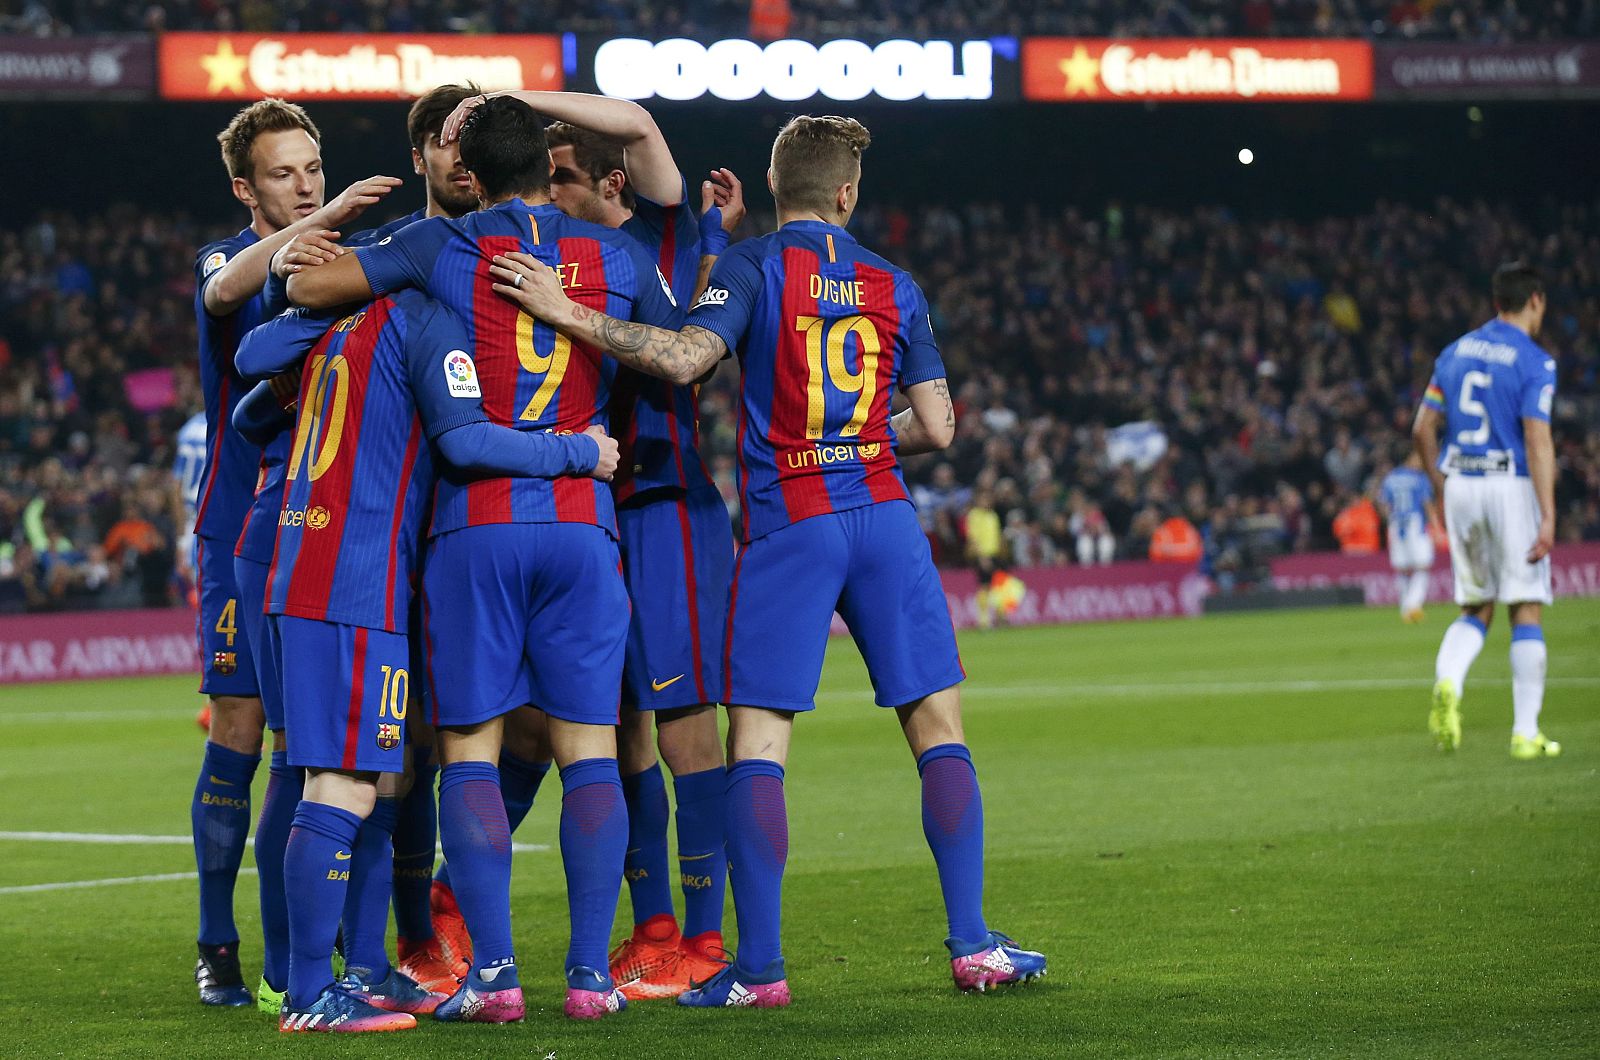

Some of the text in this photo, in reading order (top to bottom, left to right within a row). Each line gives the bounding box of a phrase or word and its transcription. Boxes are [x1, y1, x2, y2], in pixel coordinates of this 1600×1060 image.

[697, 286, 729, 303] eko
[809, 273, 866, 306] DIGNE
[516, 309, 572, 421] 9
[796, 315, 881, 440] 19
[287, 354, 350, 482] 10
[1457, 370, 1493, 446] 5
[215, 599, 238, 646] 4
[379, 665, 409, 720] 10
[681, 873, 712, 890] ARÇA
